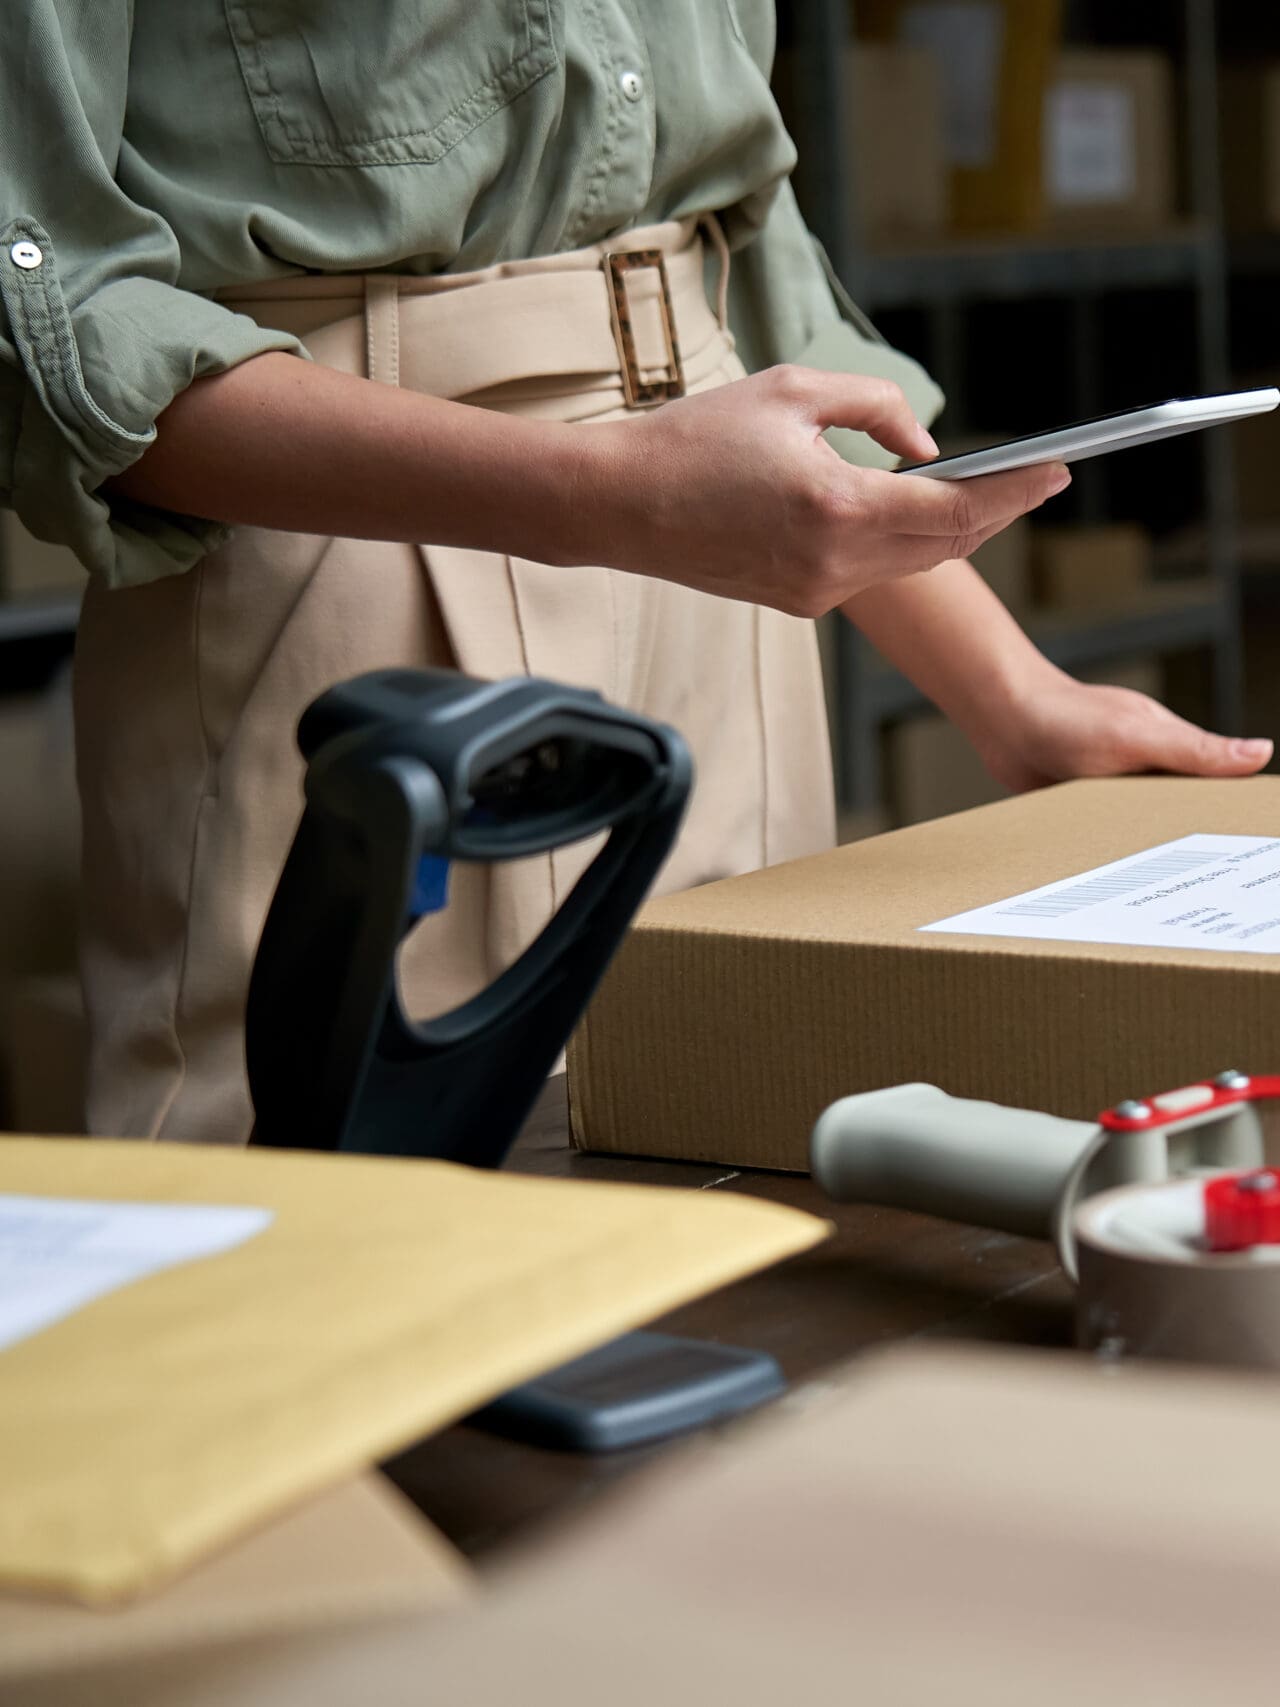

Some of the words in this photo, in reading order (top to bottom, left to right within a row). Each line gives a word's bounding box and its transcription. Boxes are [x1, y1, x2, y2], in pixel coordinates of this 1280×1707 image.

[1206, 867, 1242, 877] Free
[1154, 876, 1217, 894] Shipping
[1122, 893, 1171, 907] Parcel
